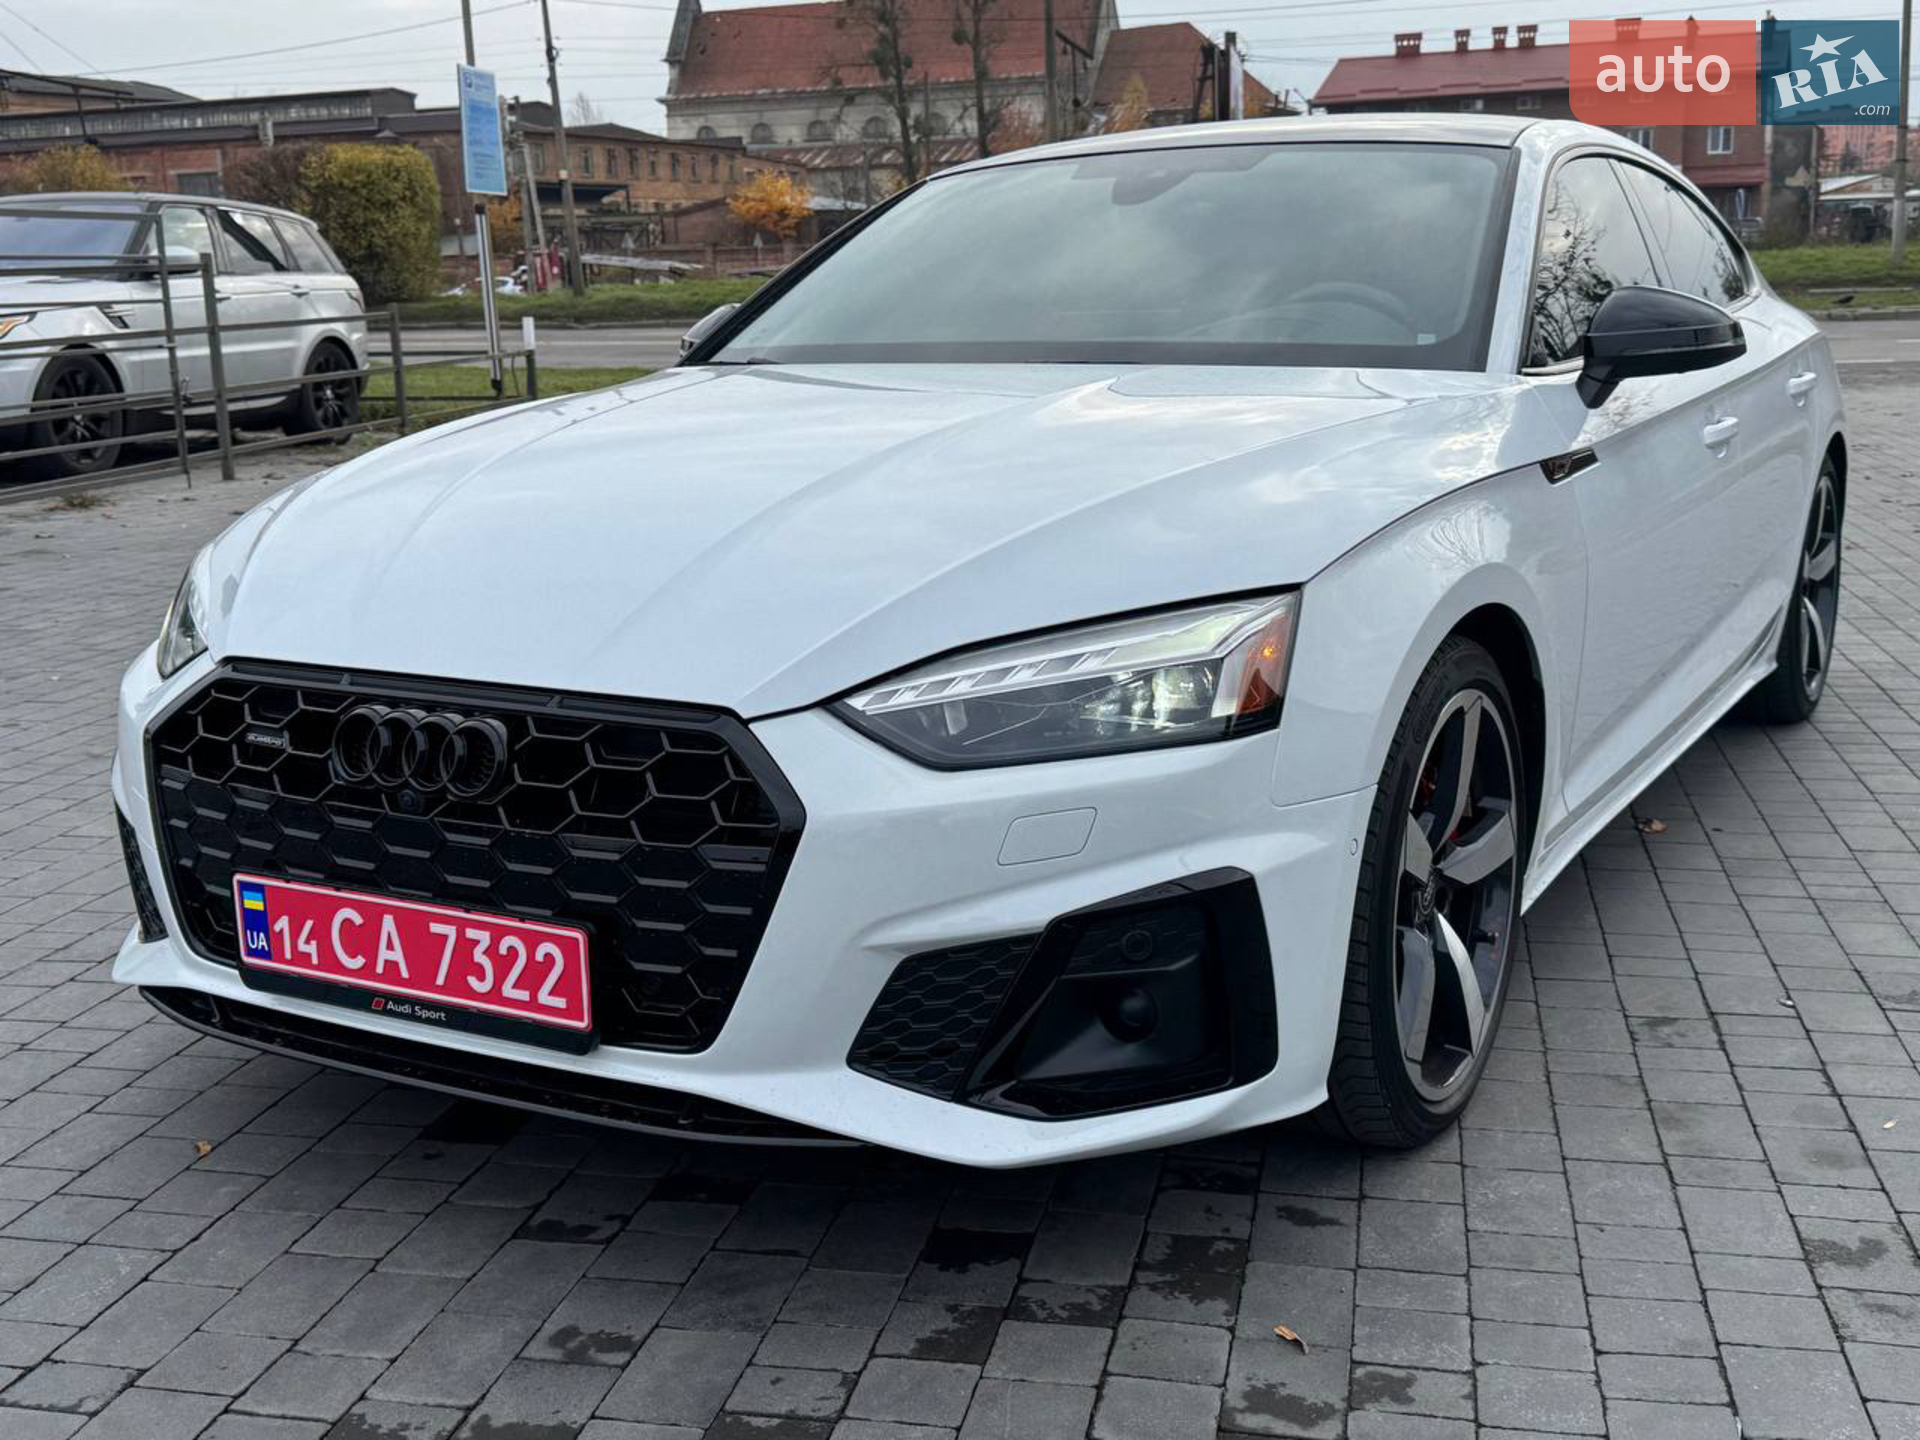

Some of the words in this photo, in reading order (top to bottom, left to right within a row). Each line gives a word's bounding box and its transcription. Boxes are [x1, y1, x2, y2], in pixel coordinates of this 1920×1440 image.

[246, 929, 269, 952] UA
[273, 915, 319, 965] 14
[331, 907, 410, 979] CA
[429, 922, 567, 1009] 7322
[386, 1000, 412, 1014] Audi
[414, 1006, 447, 1021] Sport
